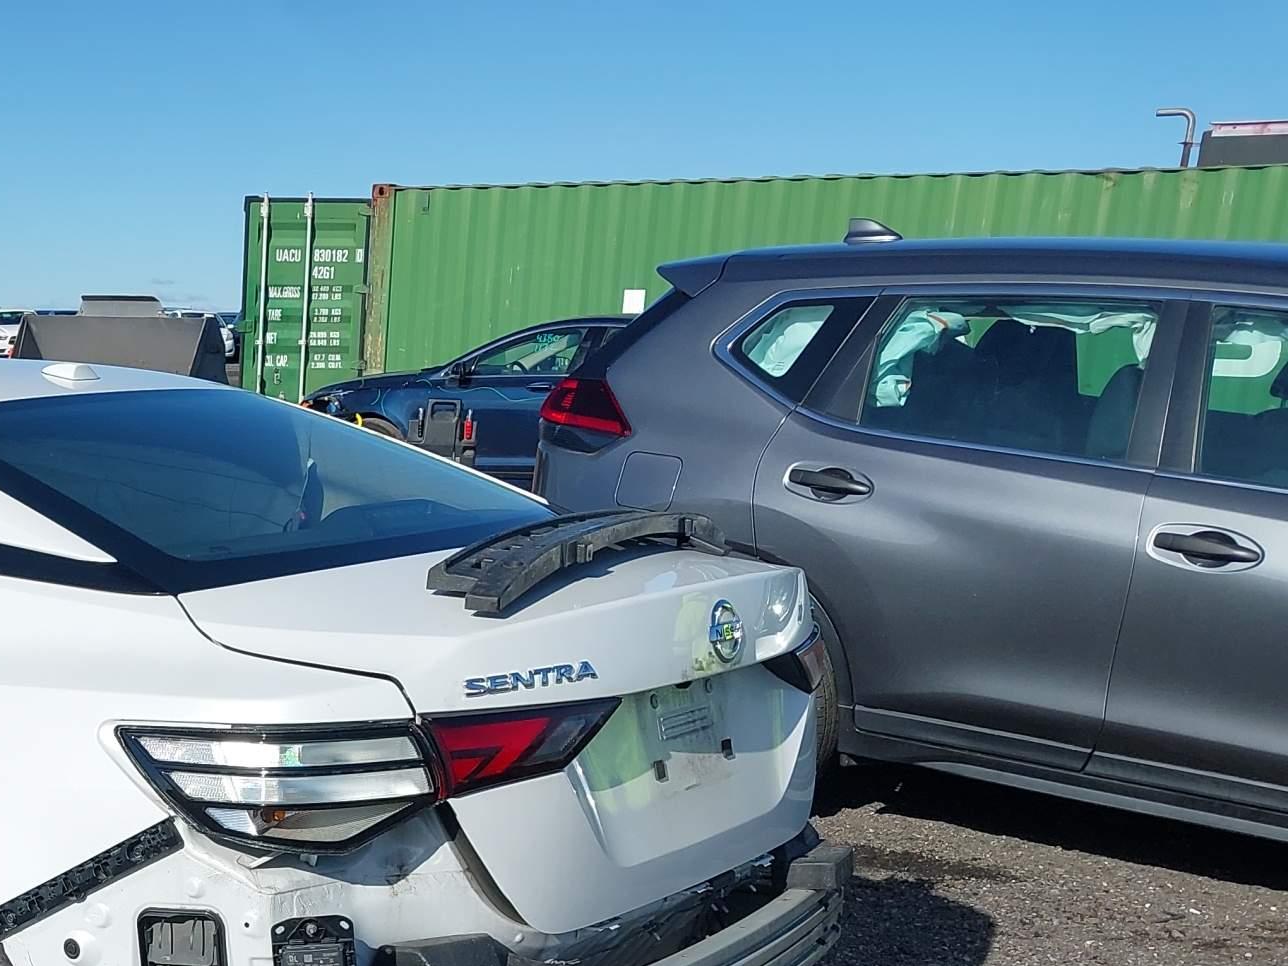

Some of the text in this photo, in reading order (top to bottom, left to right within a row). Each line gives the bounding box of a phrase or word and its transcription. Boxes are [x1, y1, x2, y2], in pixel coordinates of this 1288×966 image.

[275, 248, 302, 262] UACU
[313, 248, 349, 262] 830182
[268, 309, 282, 321] TARE
[266, 332, 277, 344] NET
[464, 660, 601, 699] SENTRA
